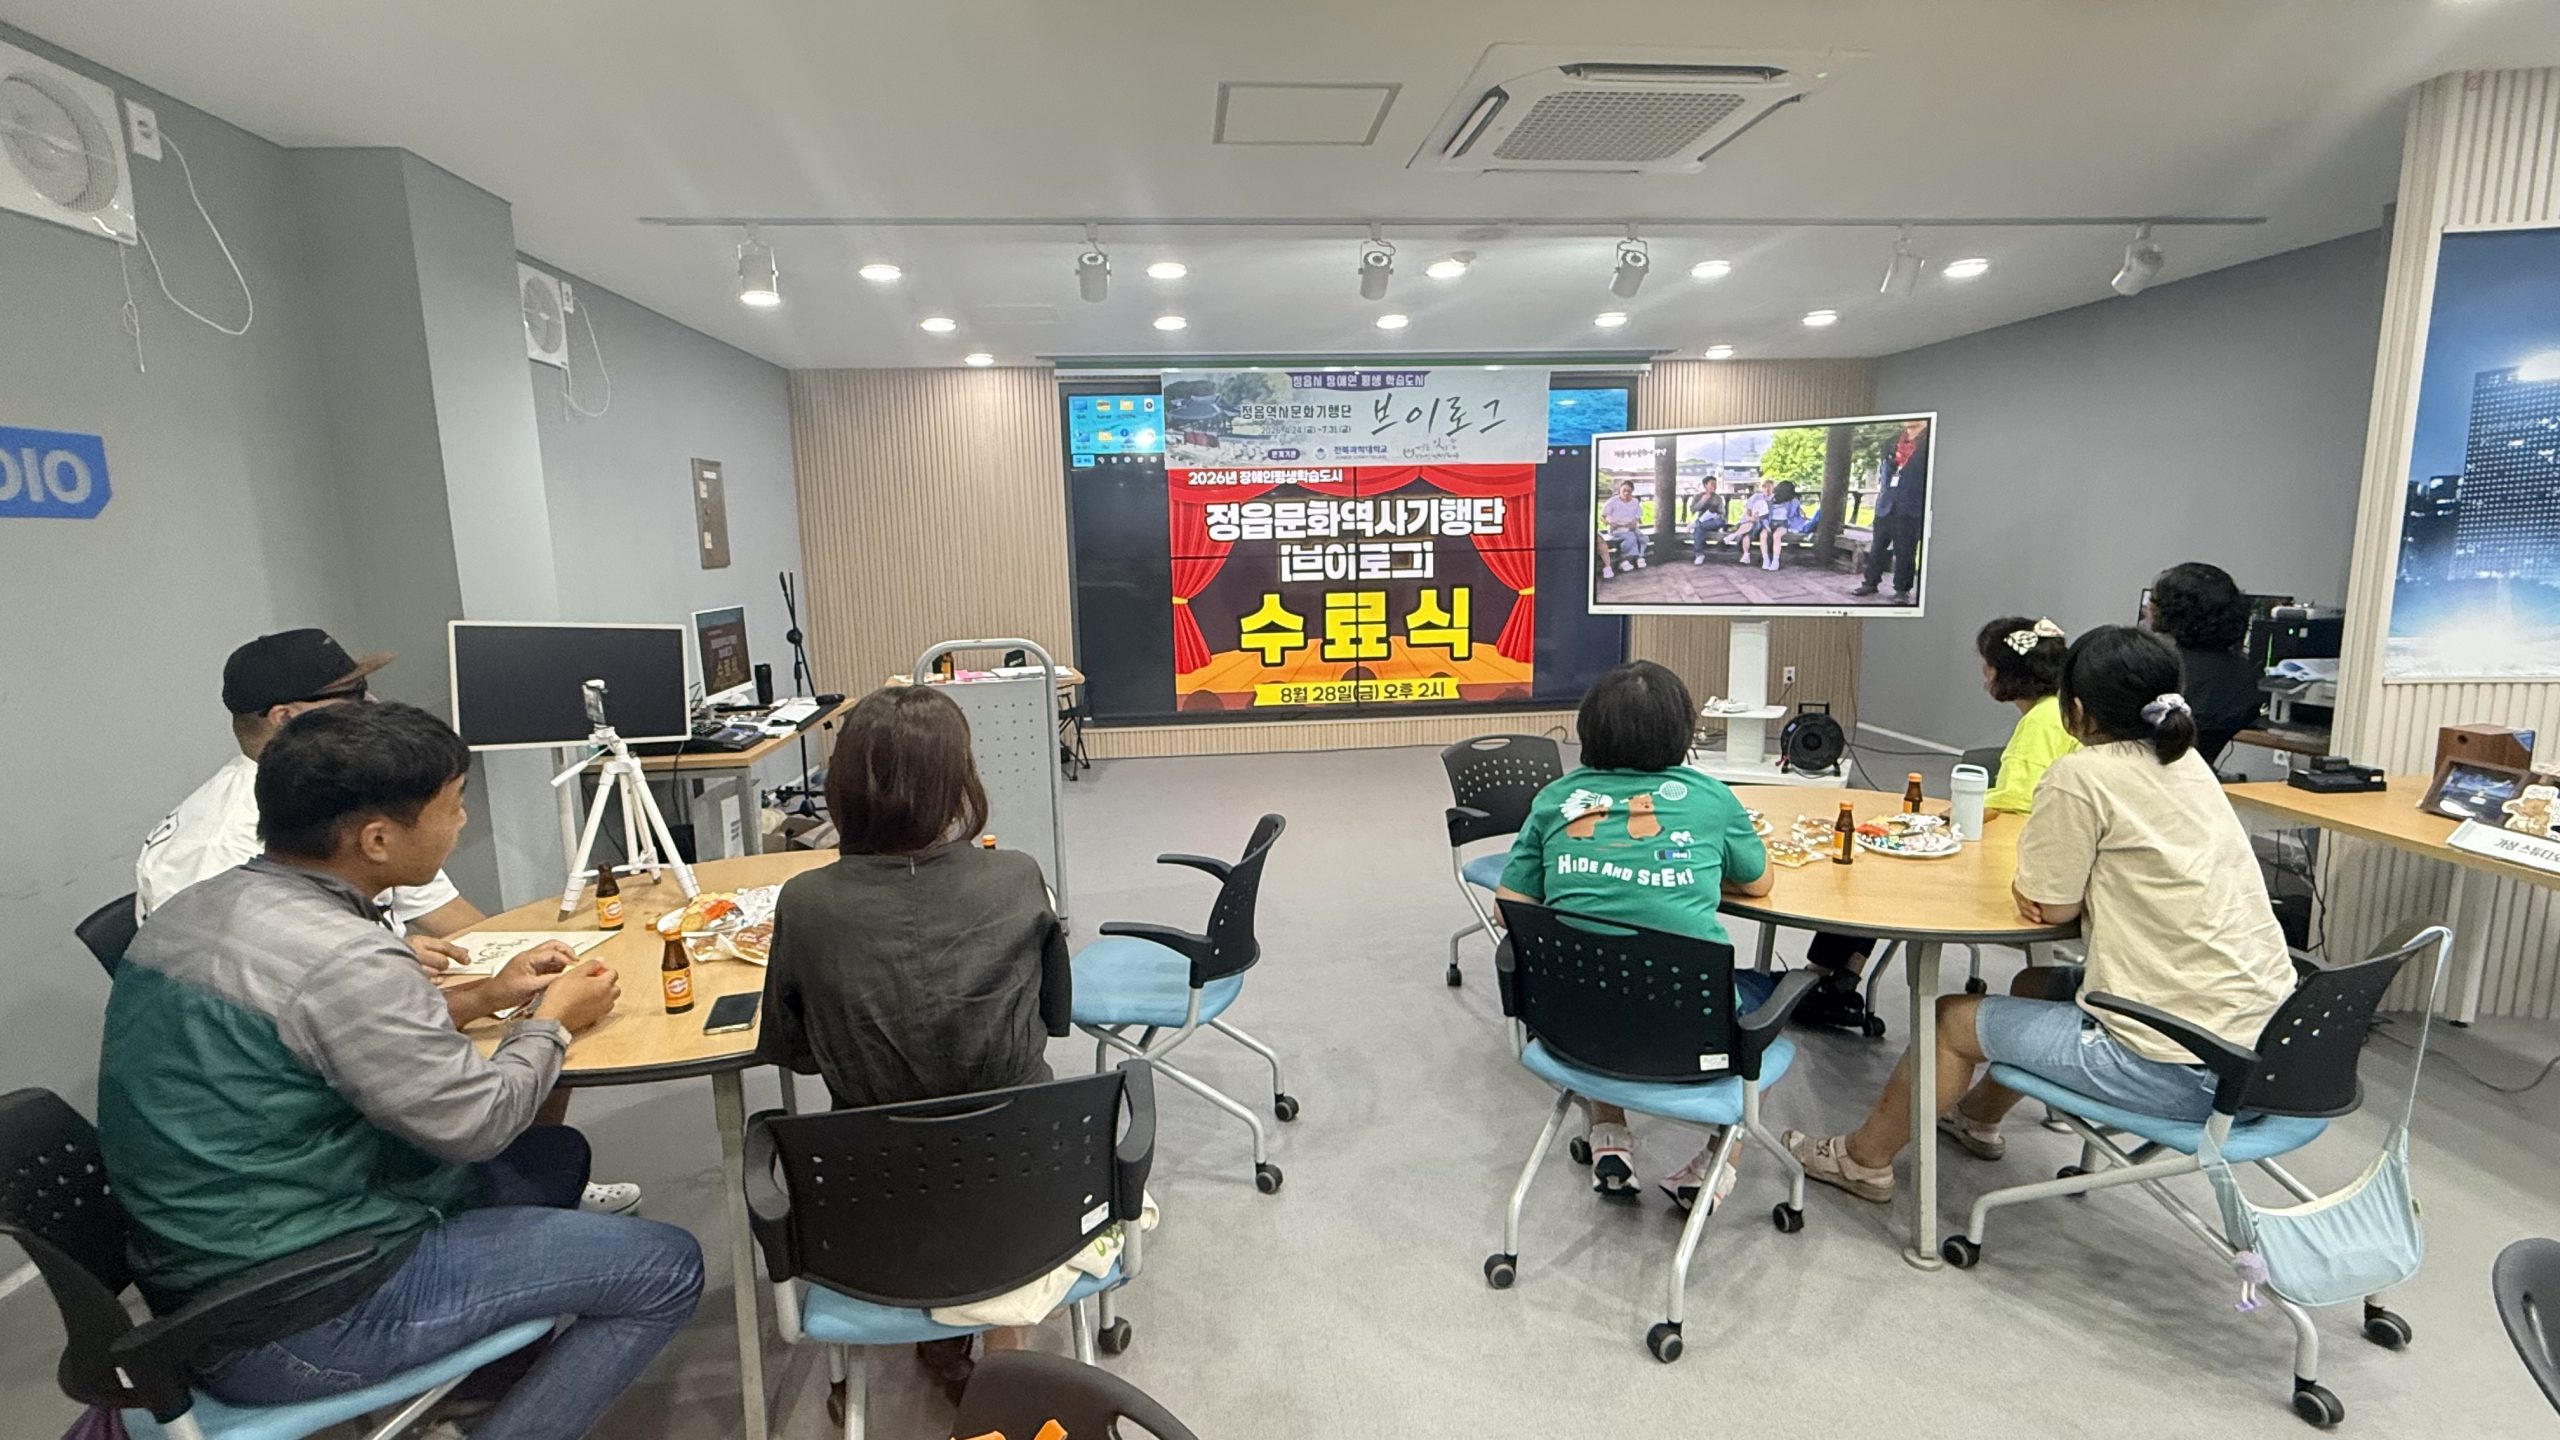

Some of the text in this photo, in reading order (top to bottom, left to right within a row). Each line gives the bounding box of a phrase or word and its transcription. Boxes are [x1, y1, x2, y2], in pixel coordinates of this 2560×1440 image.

[1293, 375, 1322, 387] 정읍시
[1326, 374, 1357, 387] 장애인
[1386, 374, 1424, 386] 학습도시
[1242, 405, 1352, 420] 정읍역사문화기행단
[1371, 392, 1506, 437] 브이로그
[1188, 469, 1343, 485] 2026년 장애인평생학습도시
[1205, 497, 1506, 541] 정읍문화역사기행단
[1281, 682, 1445, 703] 8월 28일(금) 오후 2시
[2494, 839, 2519, 850] 가상
[1601, 862, 1633, 881] AND
